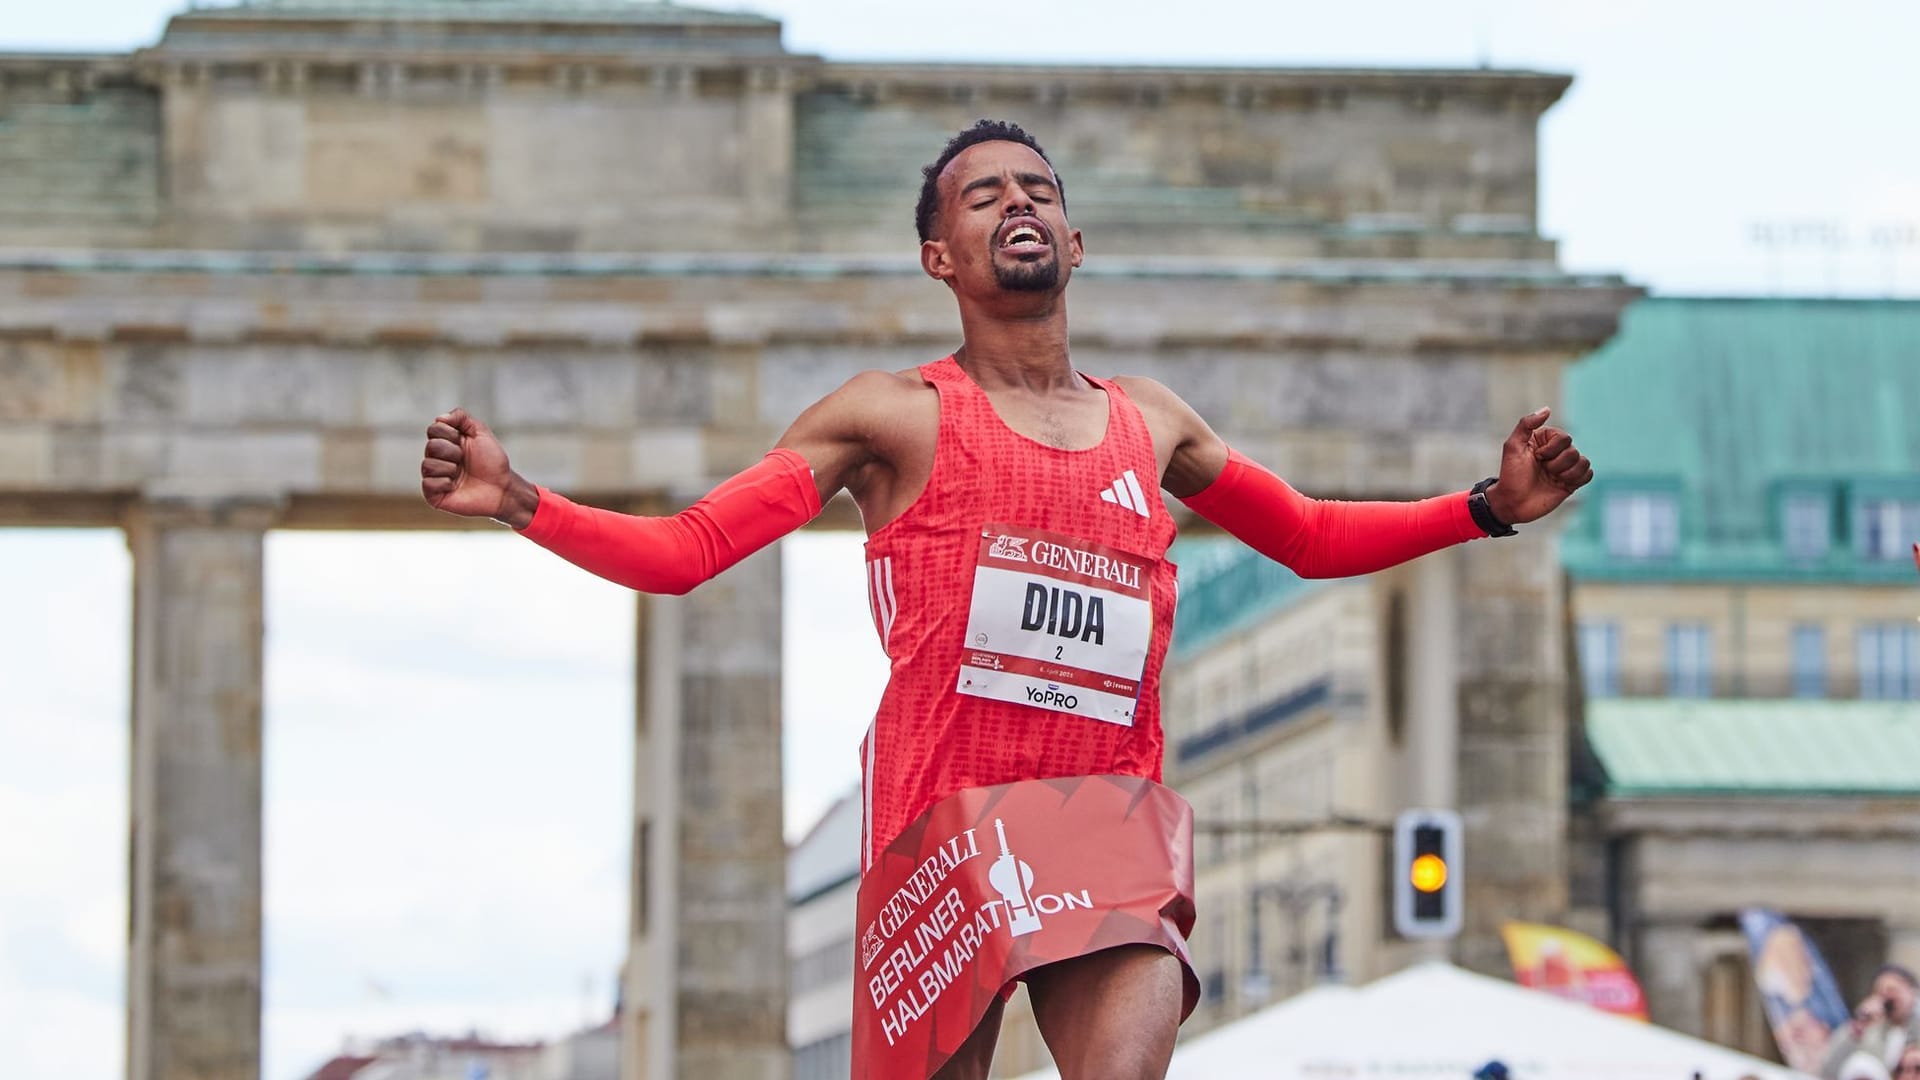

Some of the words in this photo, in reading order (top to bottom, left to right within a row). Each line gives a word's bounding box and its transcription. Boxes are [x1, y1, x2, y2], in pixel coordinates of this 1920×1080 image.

[1031, 540, 1142, 590] GENERALI
[1020, 581, 1105, 646] DIDA
[1054, 645, 1064, 661] 2
[1025, 686, 1078, 710] YoPRO
[878, 828, 982, 939] GENERALI
[868, 886, 966, 1011] BERLINER
[881, 889, 1094, 1047] HALBMARATHON
